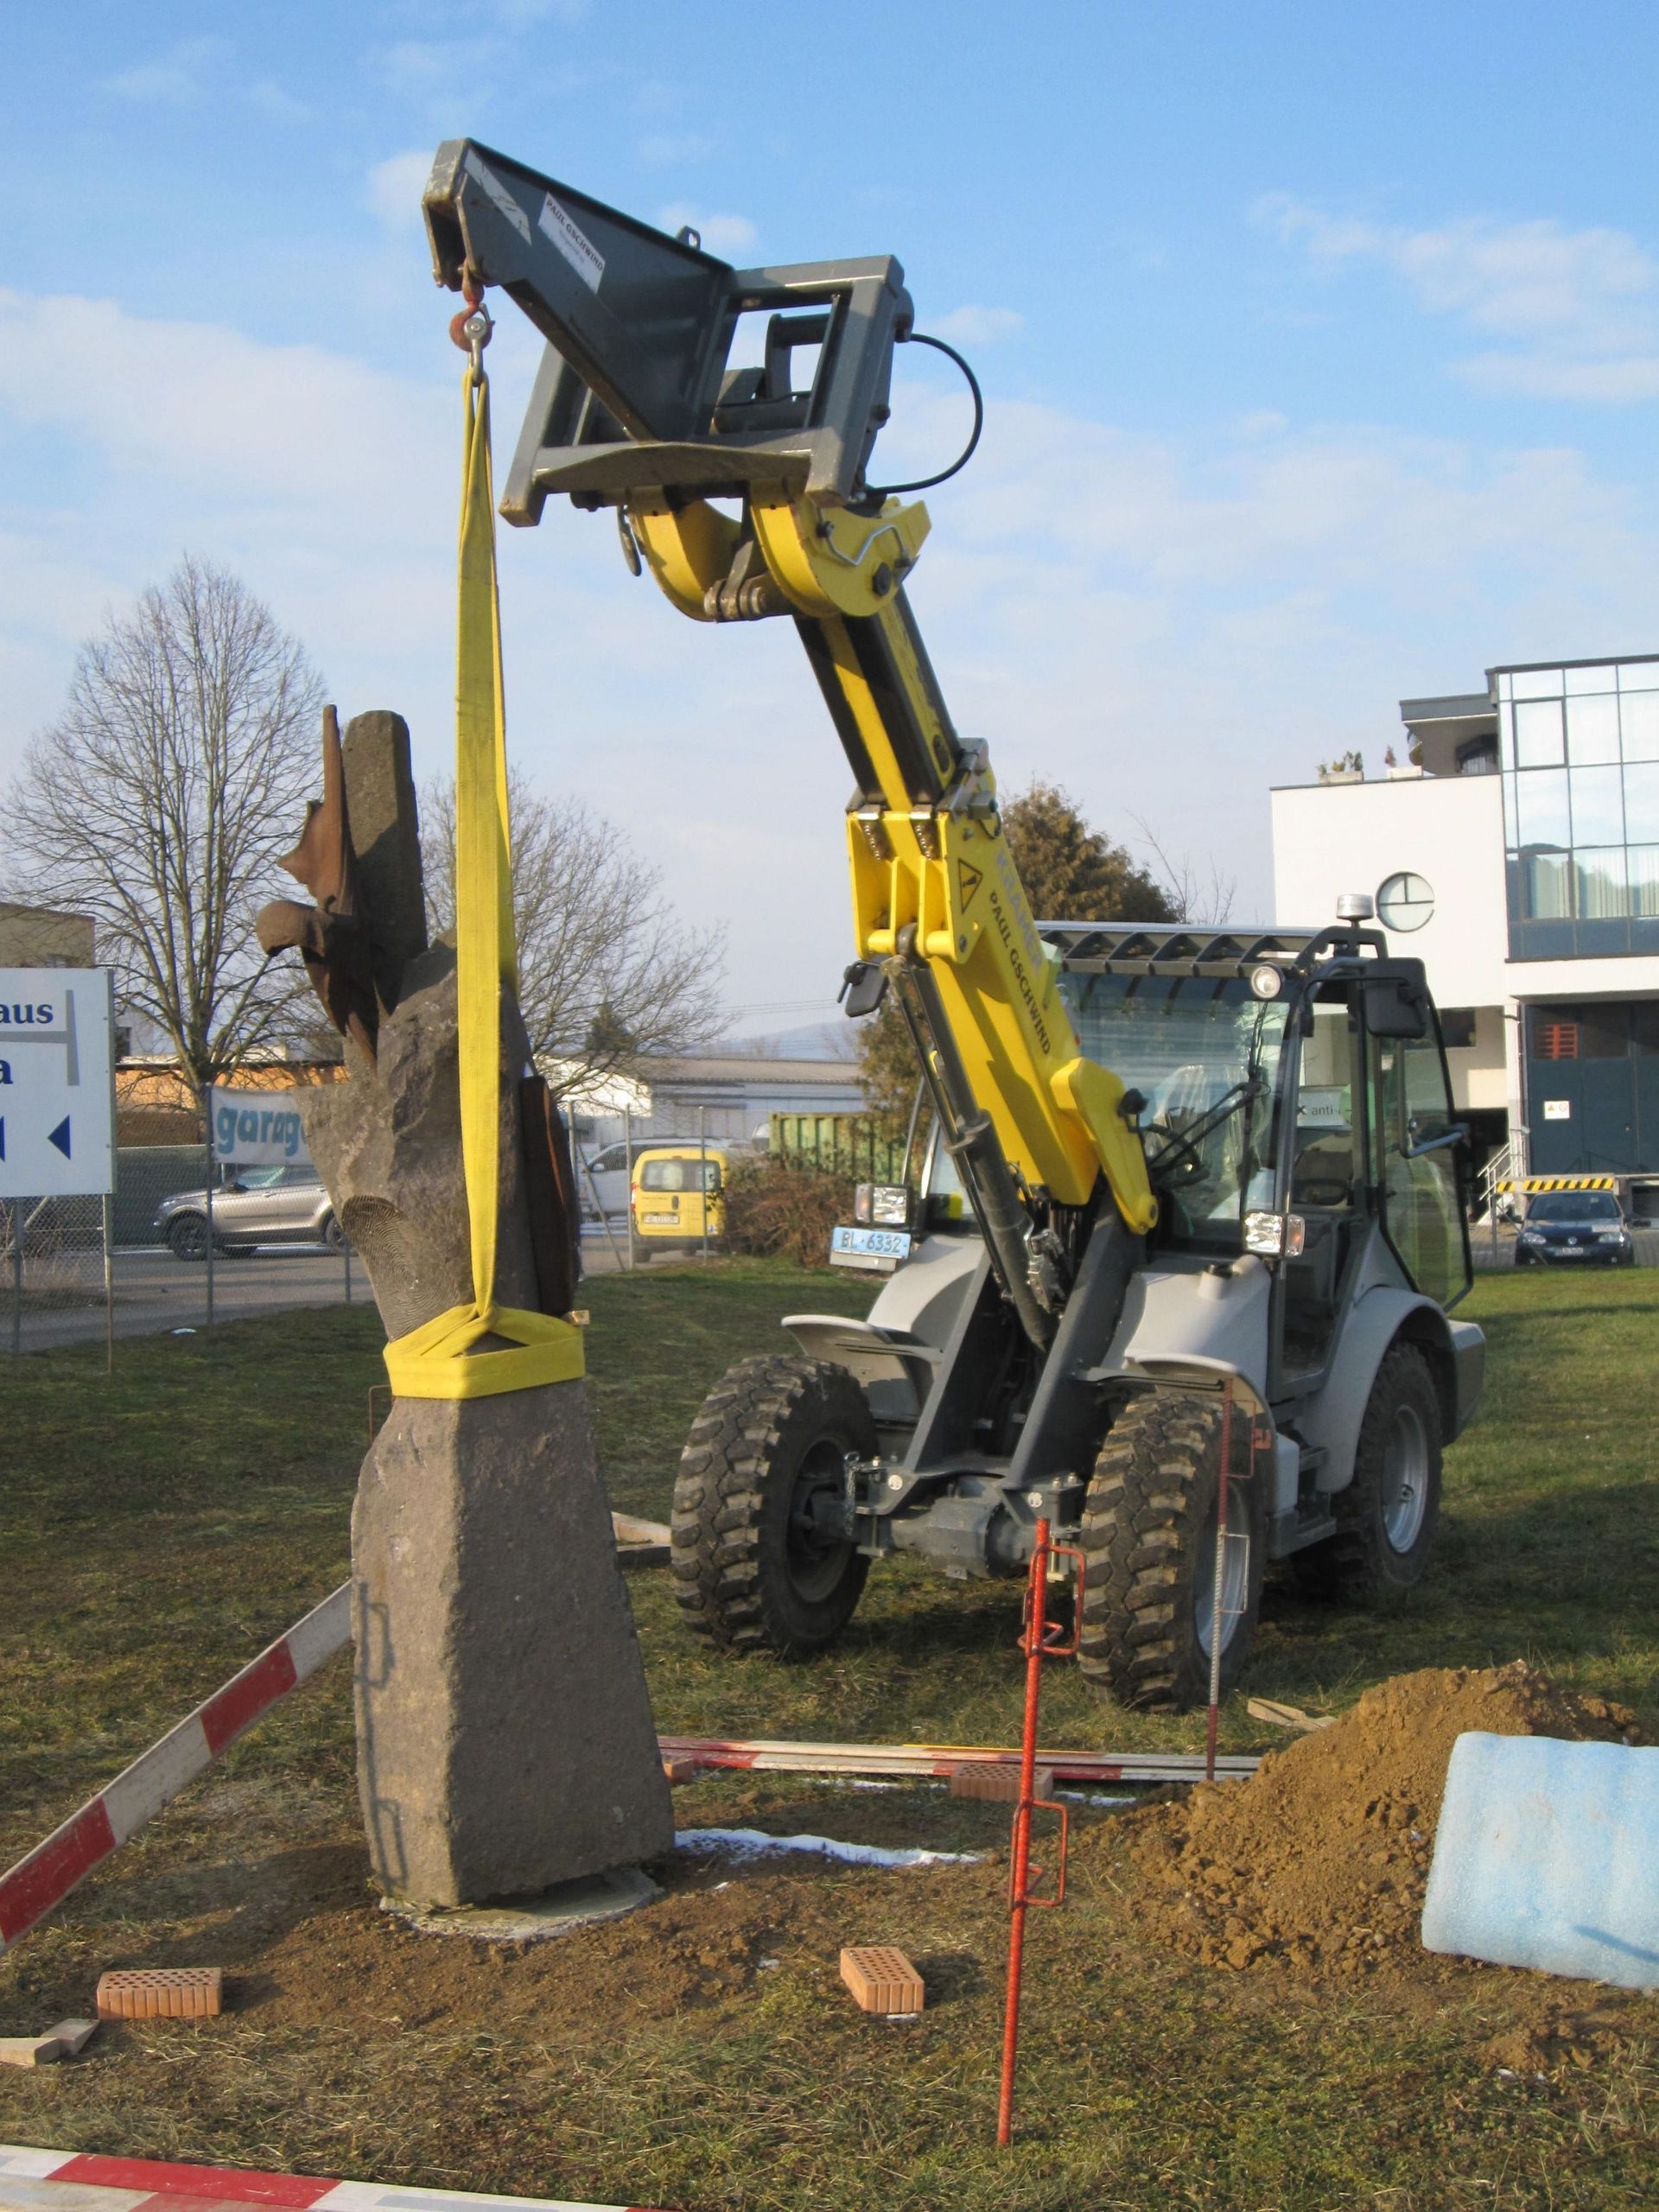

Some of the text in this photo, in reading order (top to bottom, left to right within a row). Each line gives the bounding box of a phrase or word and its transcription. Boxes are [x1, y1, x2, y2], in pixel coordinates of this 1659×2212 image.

[546, 199, 565, 226] PAUL
[565, 223, 603, 271] GSCHWIND
[989, 890, 1051, 1056] PAUL GSCHWIND
[217, 1106, 307, 1157] garag
